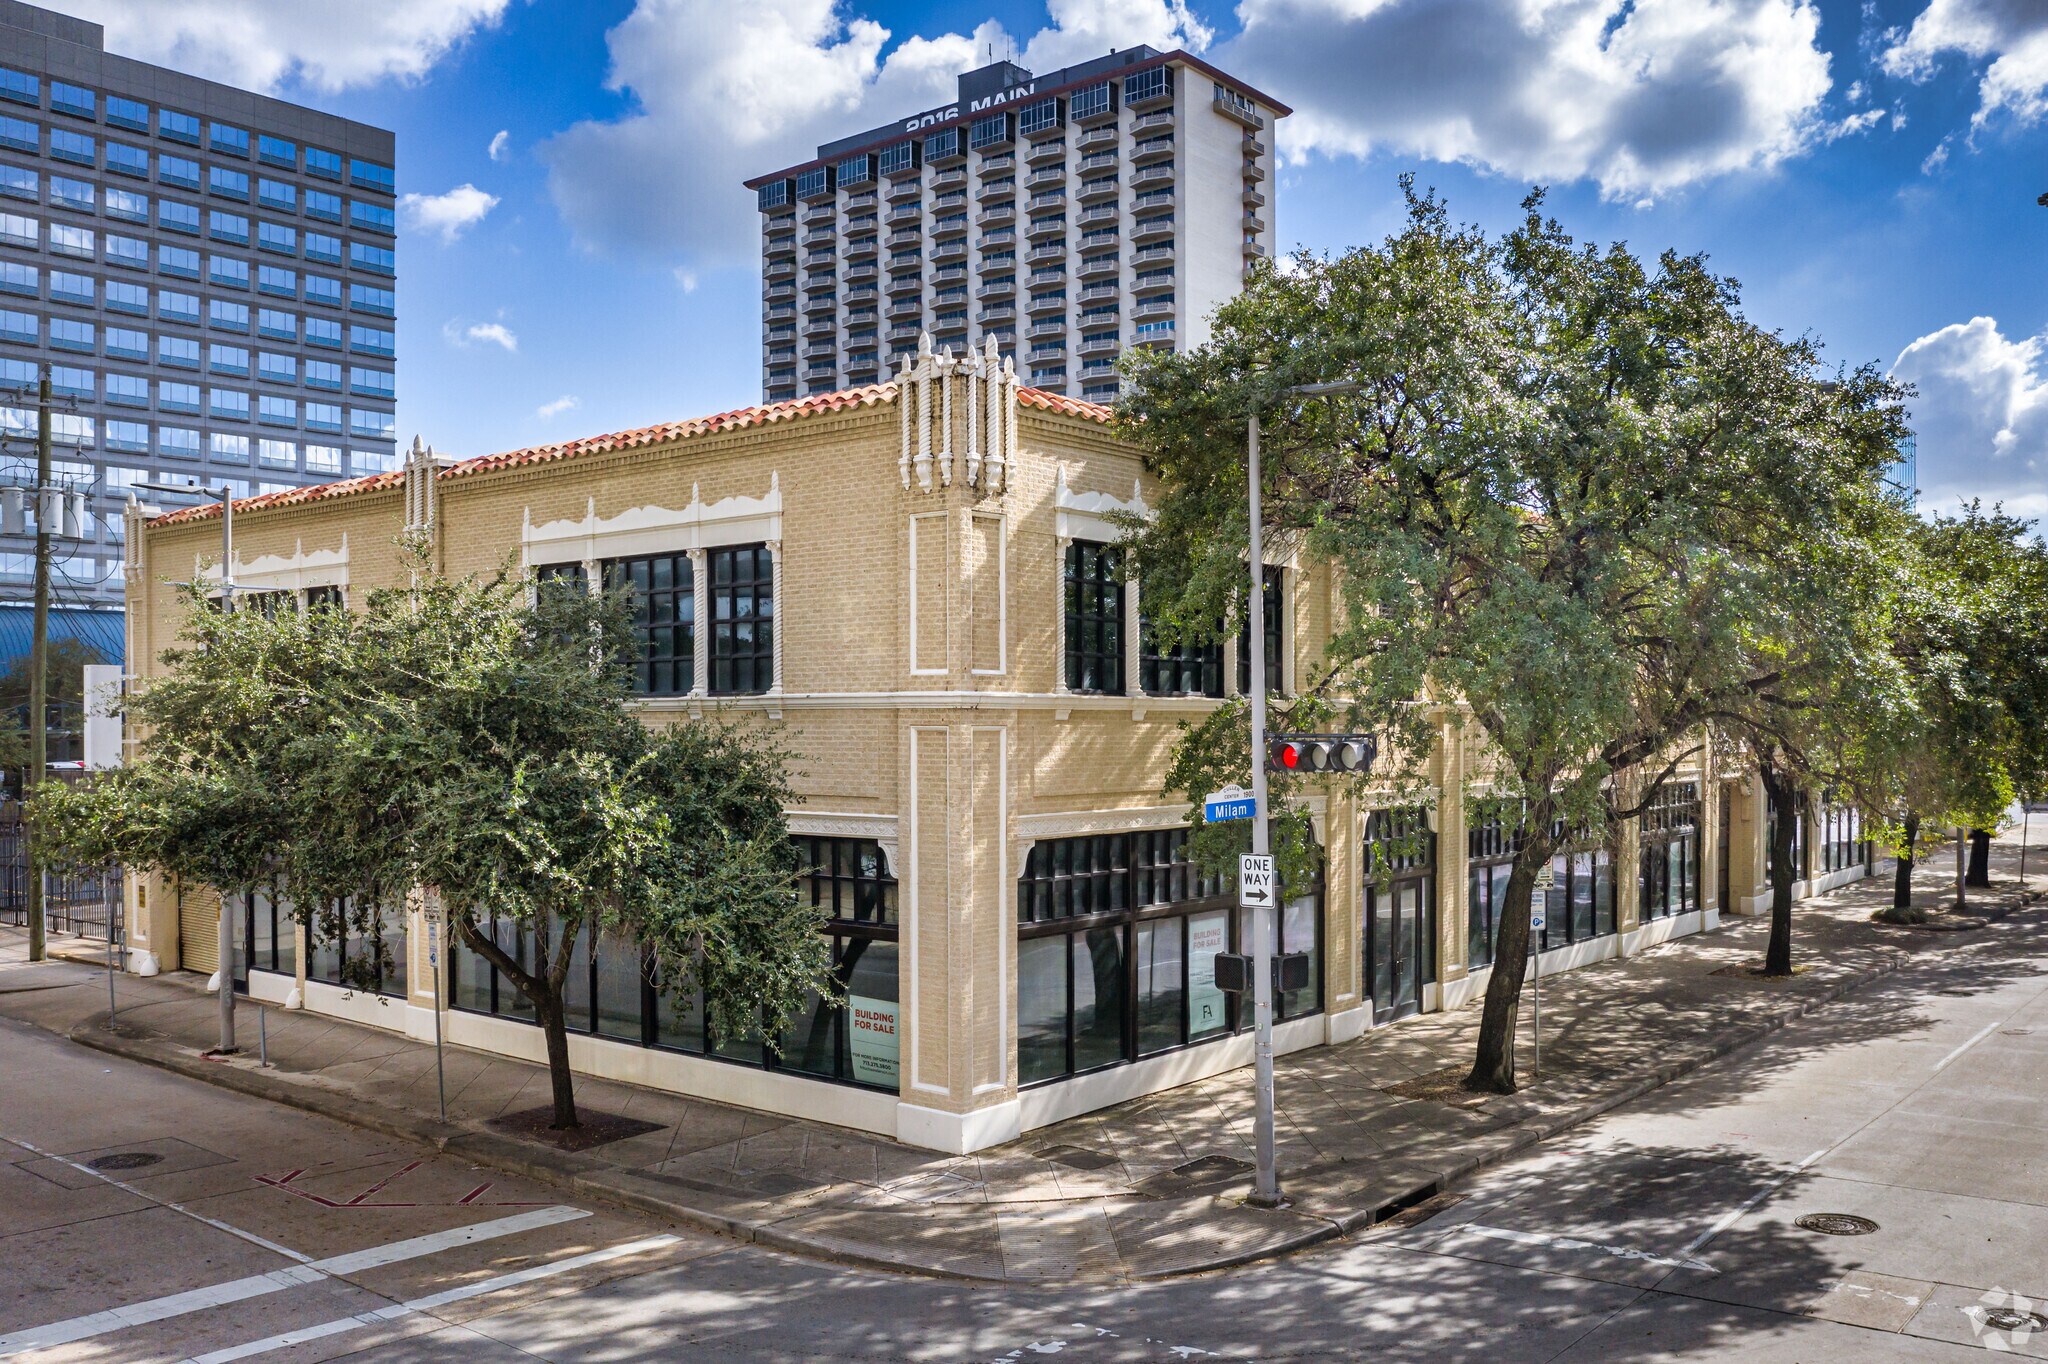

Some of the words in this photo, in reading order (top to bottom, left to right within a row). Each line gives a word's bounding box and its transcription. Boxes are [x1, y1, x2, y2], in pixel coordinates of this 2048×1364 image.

[970, 83, 1035, 112] MAIN
[1243, 790, 1254, 798] 1900
[1215, 805, 1247, 818] Milam
[1244, 858, 1269, 872] ONE
[1244, 873, 1270, 886] WAY
[1193, 928, 1221, 940] BUILDING
[1193, 940, 1205, 950] FOR
[1206, 937, 1221, 947] SALE
[855, 1009, 894, 1023] BUILDING
[854, 1020, 871, 1030] FOR
[873, 1023, 895, 1034] SALE
